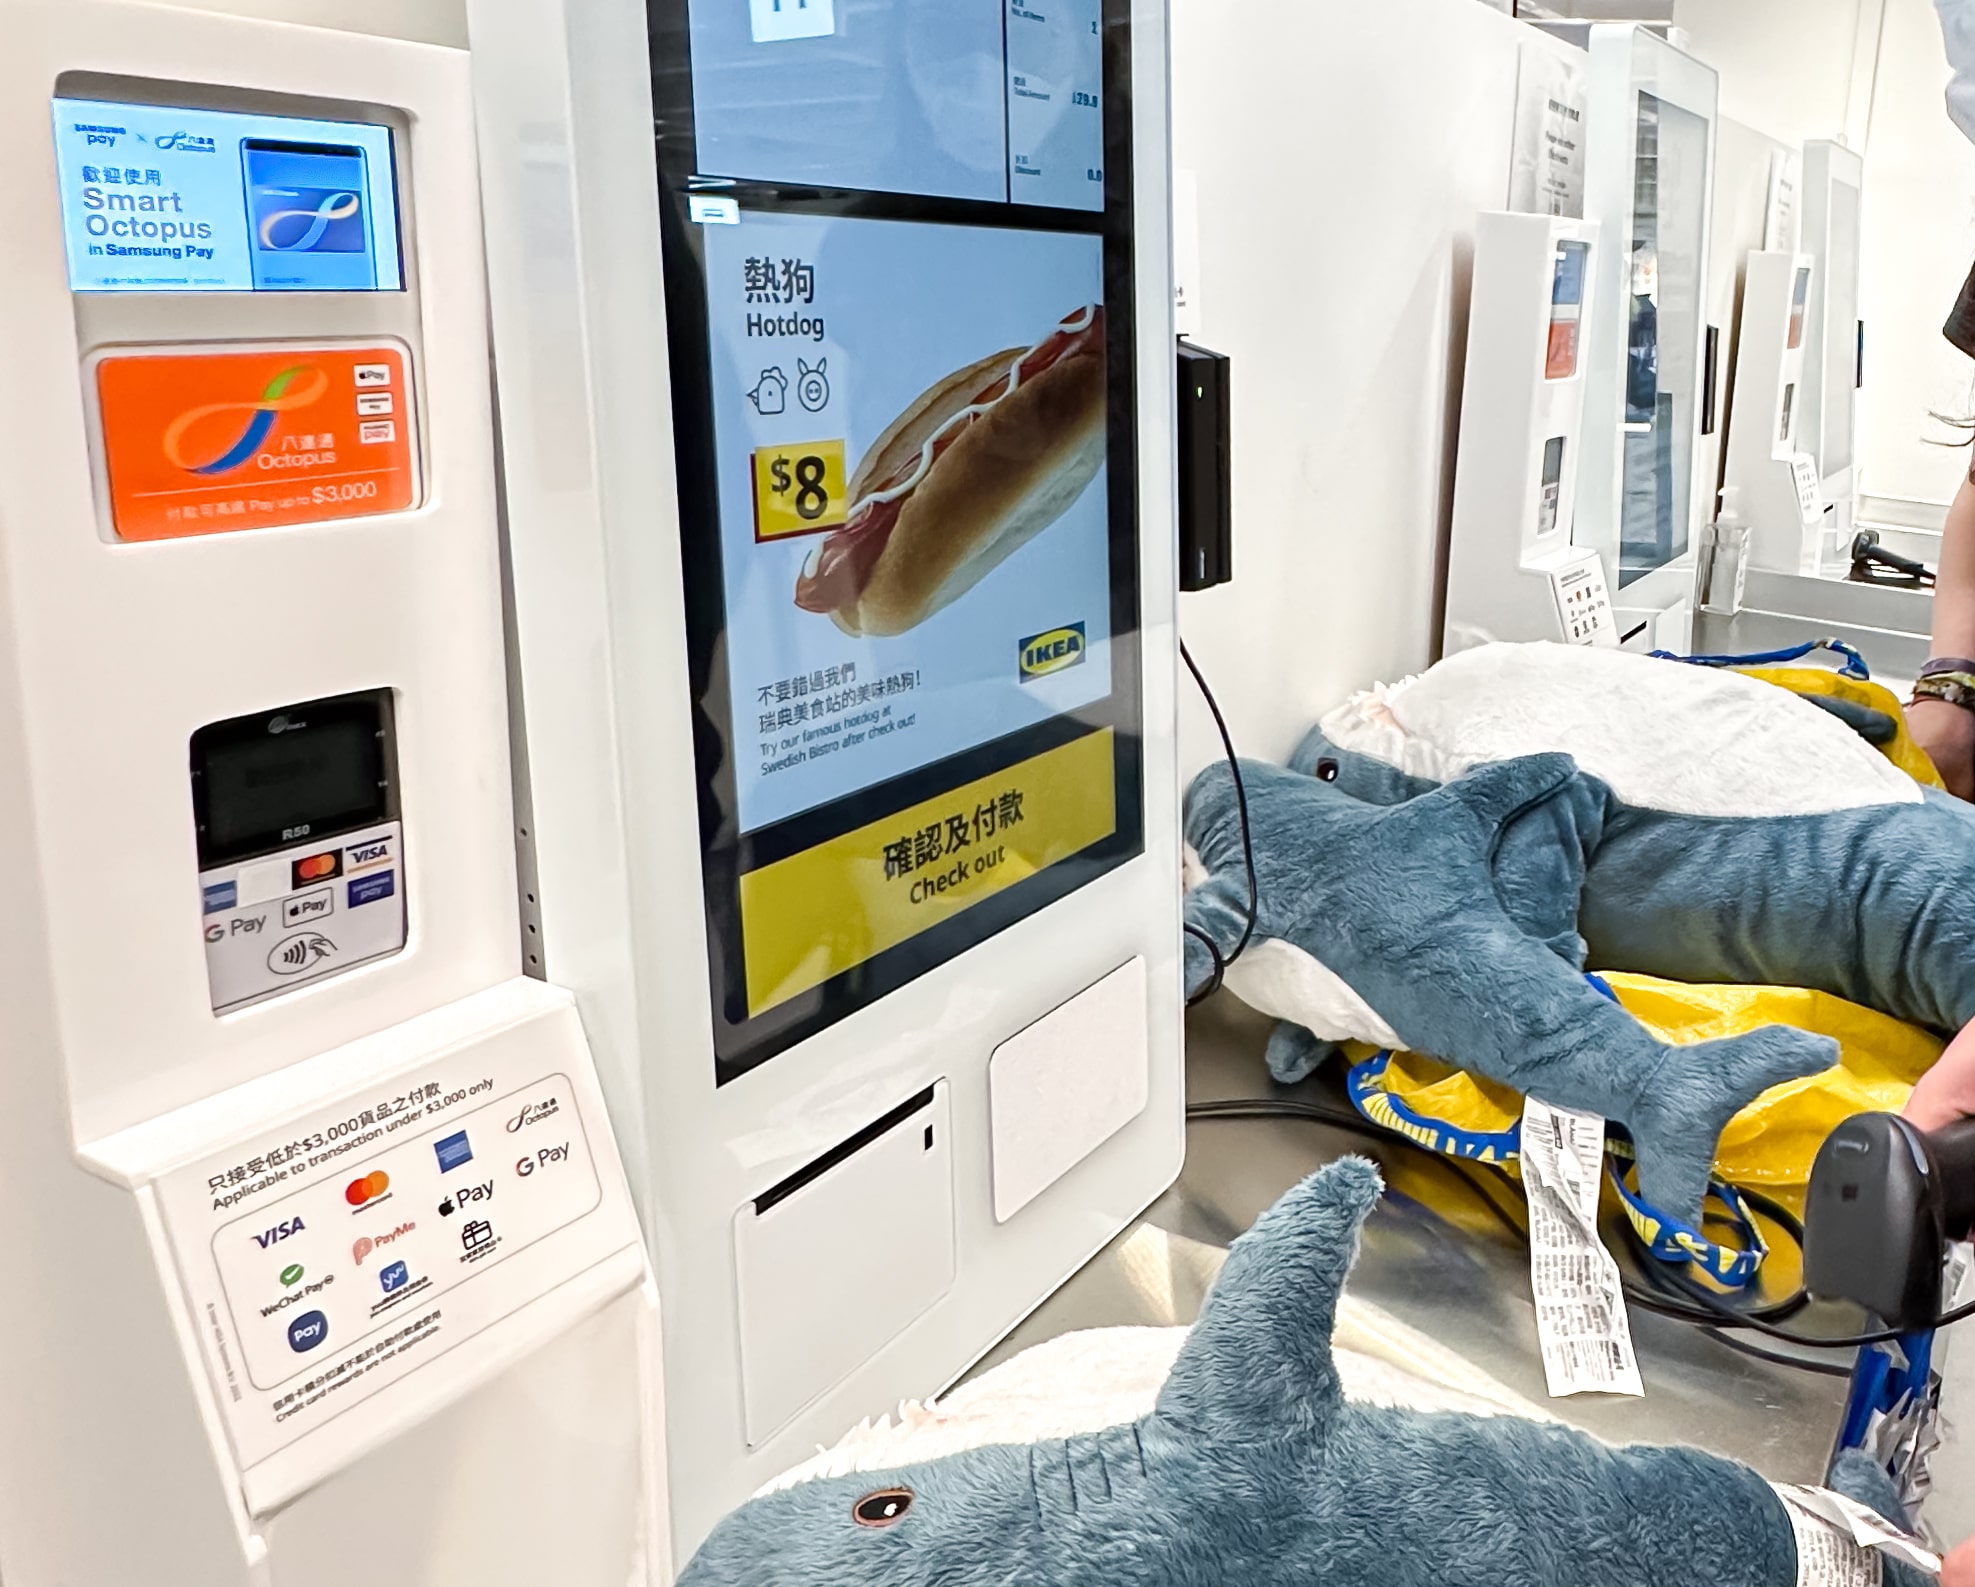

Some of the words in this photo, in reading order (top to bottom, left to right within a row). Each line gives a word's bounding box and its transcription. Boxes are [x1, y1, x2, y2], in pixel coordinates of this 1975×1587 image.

[83, 187, 183, 213] Smart
[86, 214, 212, 243] Octopus
[106, 243, 182, 260] Samsung
[186, 244, 215, 260] Pay
[744, 256, 814, 304] 熱狗
[746, 311, 824, 342] Hotdog
[257, 451, 336, 470] Octopus
[249, 499, 274, 512] Pay
[278, 498, 295, 509] up
[296, 496, 310, 506] to
[311, 481, 377, 504] $3,000
[770, 453, 828, 519] $8
[1024, 635, 1081, 668] IKEA
[757, 662, 856, 706] 不要錯過我們
[760, 742, 777, 757] Try
[780, 735, 800, 750] our
[802, 723, 842, 744] famous
[844, 709, 880, 730] hotdog
[882, 705, 892, 717] at
[761, 750, 807, 776] Swedish
[809, 740, 839, 760] Bistro
[841, 731, 867, 749] after
[868, 720, 896, 740] check
[897, 713, 916, 729] out!
[282, 824, 310, 840] R50
[883, 788, 1024, 882] 確認及付款
[351, 844, 388, 863] VISA
[910, 860, 970, 905] Check
[974, 845, 1005, 874] out
[302, 899, 328, 914] Pay
[230, 915, 267, 936] Pay
[525, 1106, 559, 1125] Octopus
[213, 1171, 288, 1210] Applicable
[290, 1163, 306, 1175] to
[308, 1128, 383, 1167] transaction
[386, 1109, 422, 1132] under
[425, 1089, 466, 1114] $3,000
[469, 1079, 494, 1096] only
[537, 1141, 569, 1167] Pay
[456, 1179, 493, 1208] Pay
[250, 1216, 306, 1249] VISA
[374, 1221, 416, 1248] PayMe
[260, 1291, 304, 1317] WeChat
[305, 1280, 324, 1296] Pay
[276, 1402, 304, 1423] Credit
[306, 1390, 326, 1405] card
[328, 1369, 364, 1393] rewards
[365, 1359, 379, 1371] are
[381, 1350, 396, 1361] not
